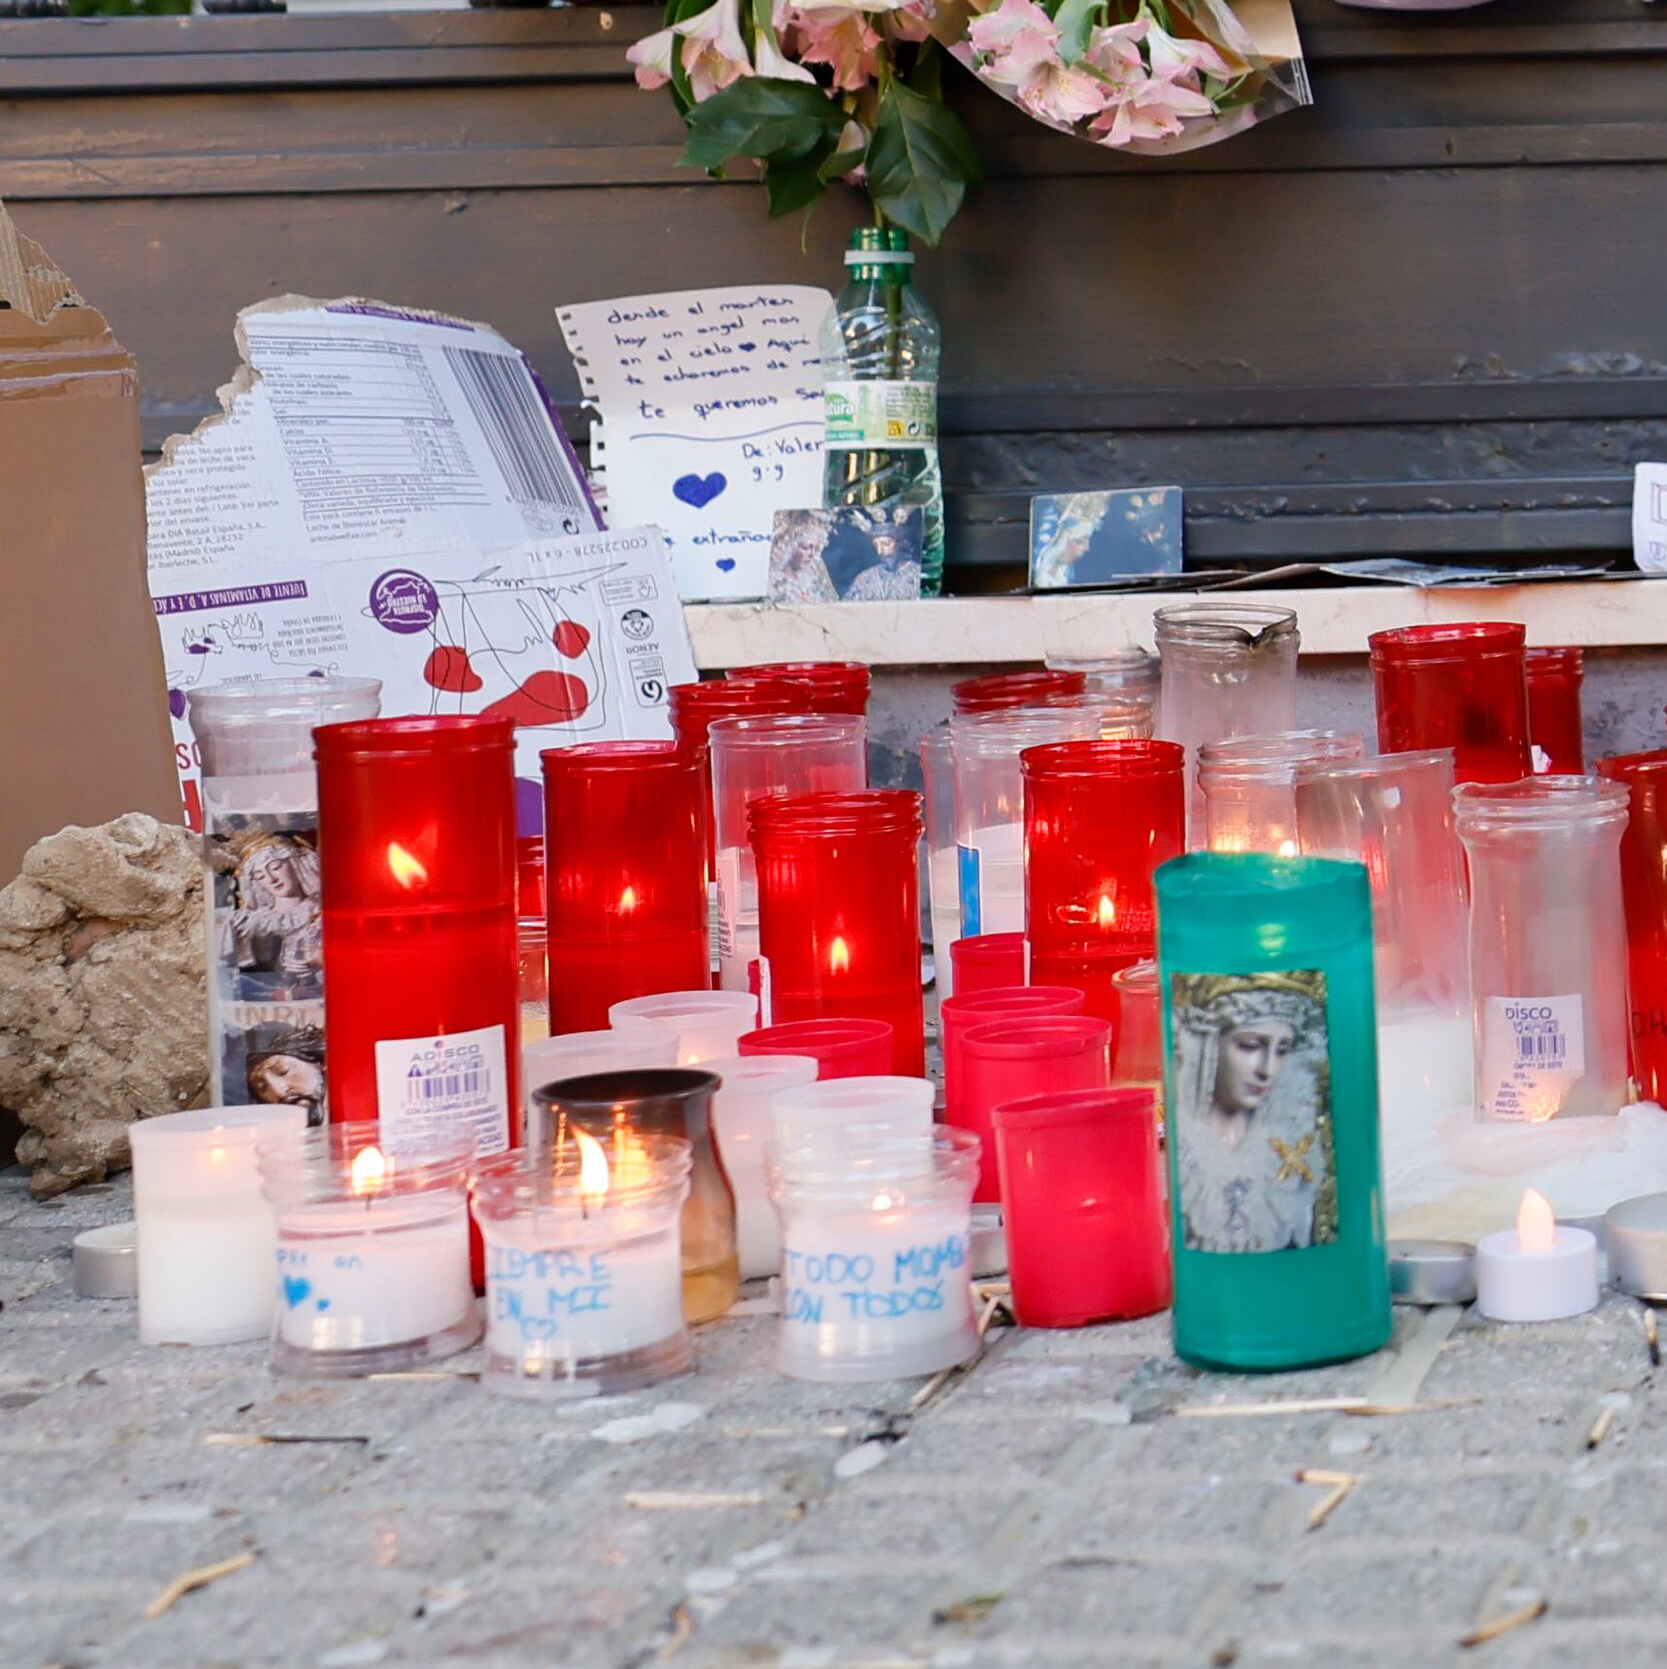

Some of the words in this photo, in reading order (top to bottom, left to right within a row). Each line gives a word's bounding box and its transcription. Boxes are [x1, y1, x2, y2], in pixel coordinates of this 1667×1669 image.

[688, 302, 704, 315] el
[663, 329, 683, 339] un
[620, 356, 641, 366] en
[657, 349, 673, 362] el
[689, 342, 732, 359] cielo
[625, 375, 644, 386] te
[767, 358, 788, 370] de
[638, 399, 666, 419] te
[209, 587, 259, 606] VITAMINAS
